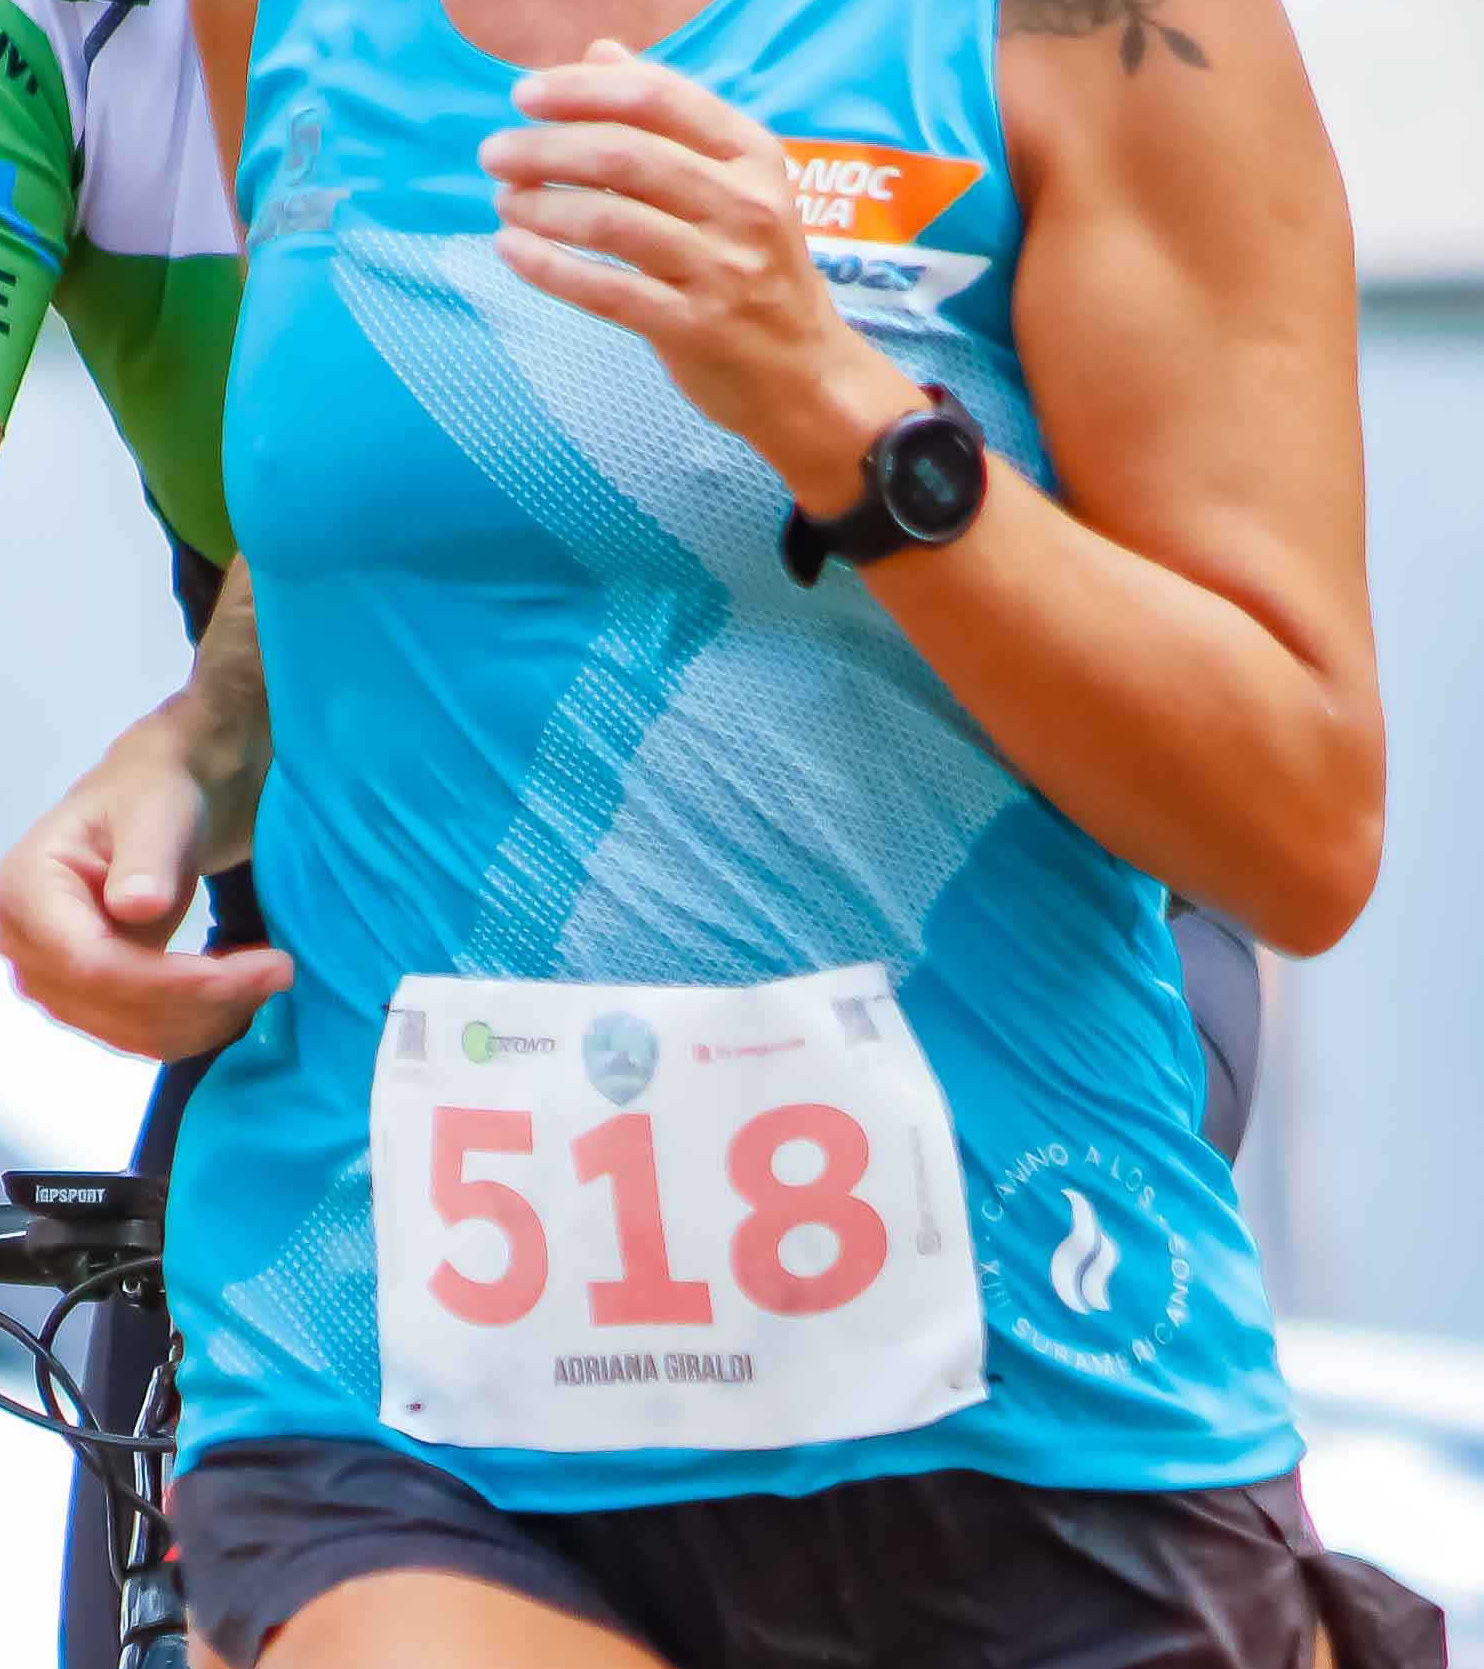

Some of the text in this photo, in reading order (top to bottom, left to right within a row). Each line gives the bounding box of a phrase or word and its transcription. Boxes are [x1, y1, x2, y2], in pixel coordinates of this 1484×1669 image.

[426, 1102, 888, 1328] 518
[980, 1142, 1070, 1223] CAMINO
[1084, 1144, 1103, 1166] A
[1109, 1153, 1158, 1213] LOS
[553, 1352, 660, 1386] ADRIANA
